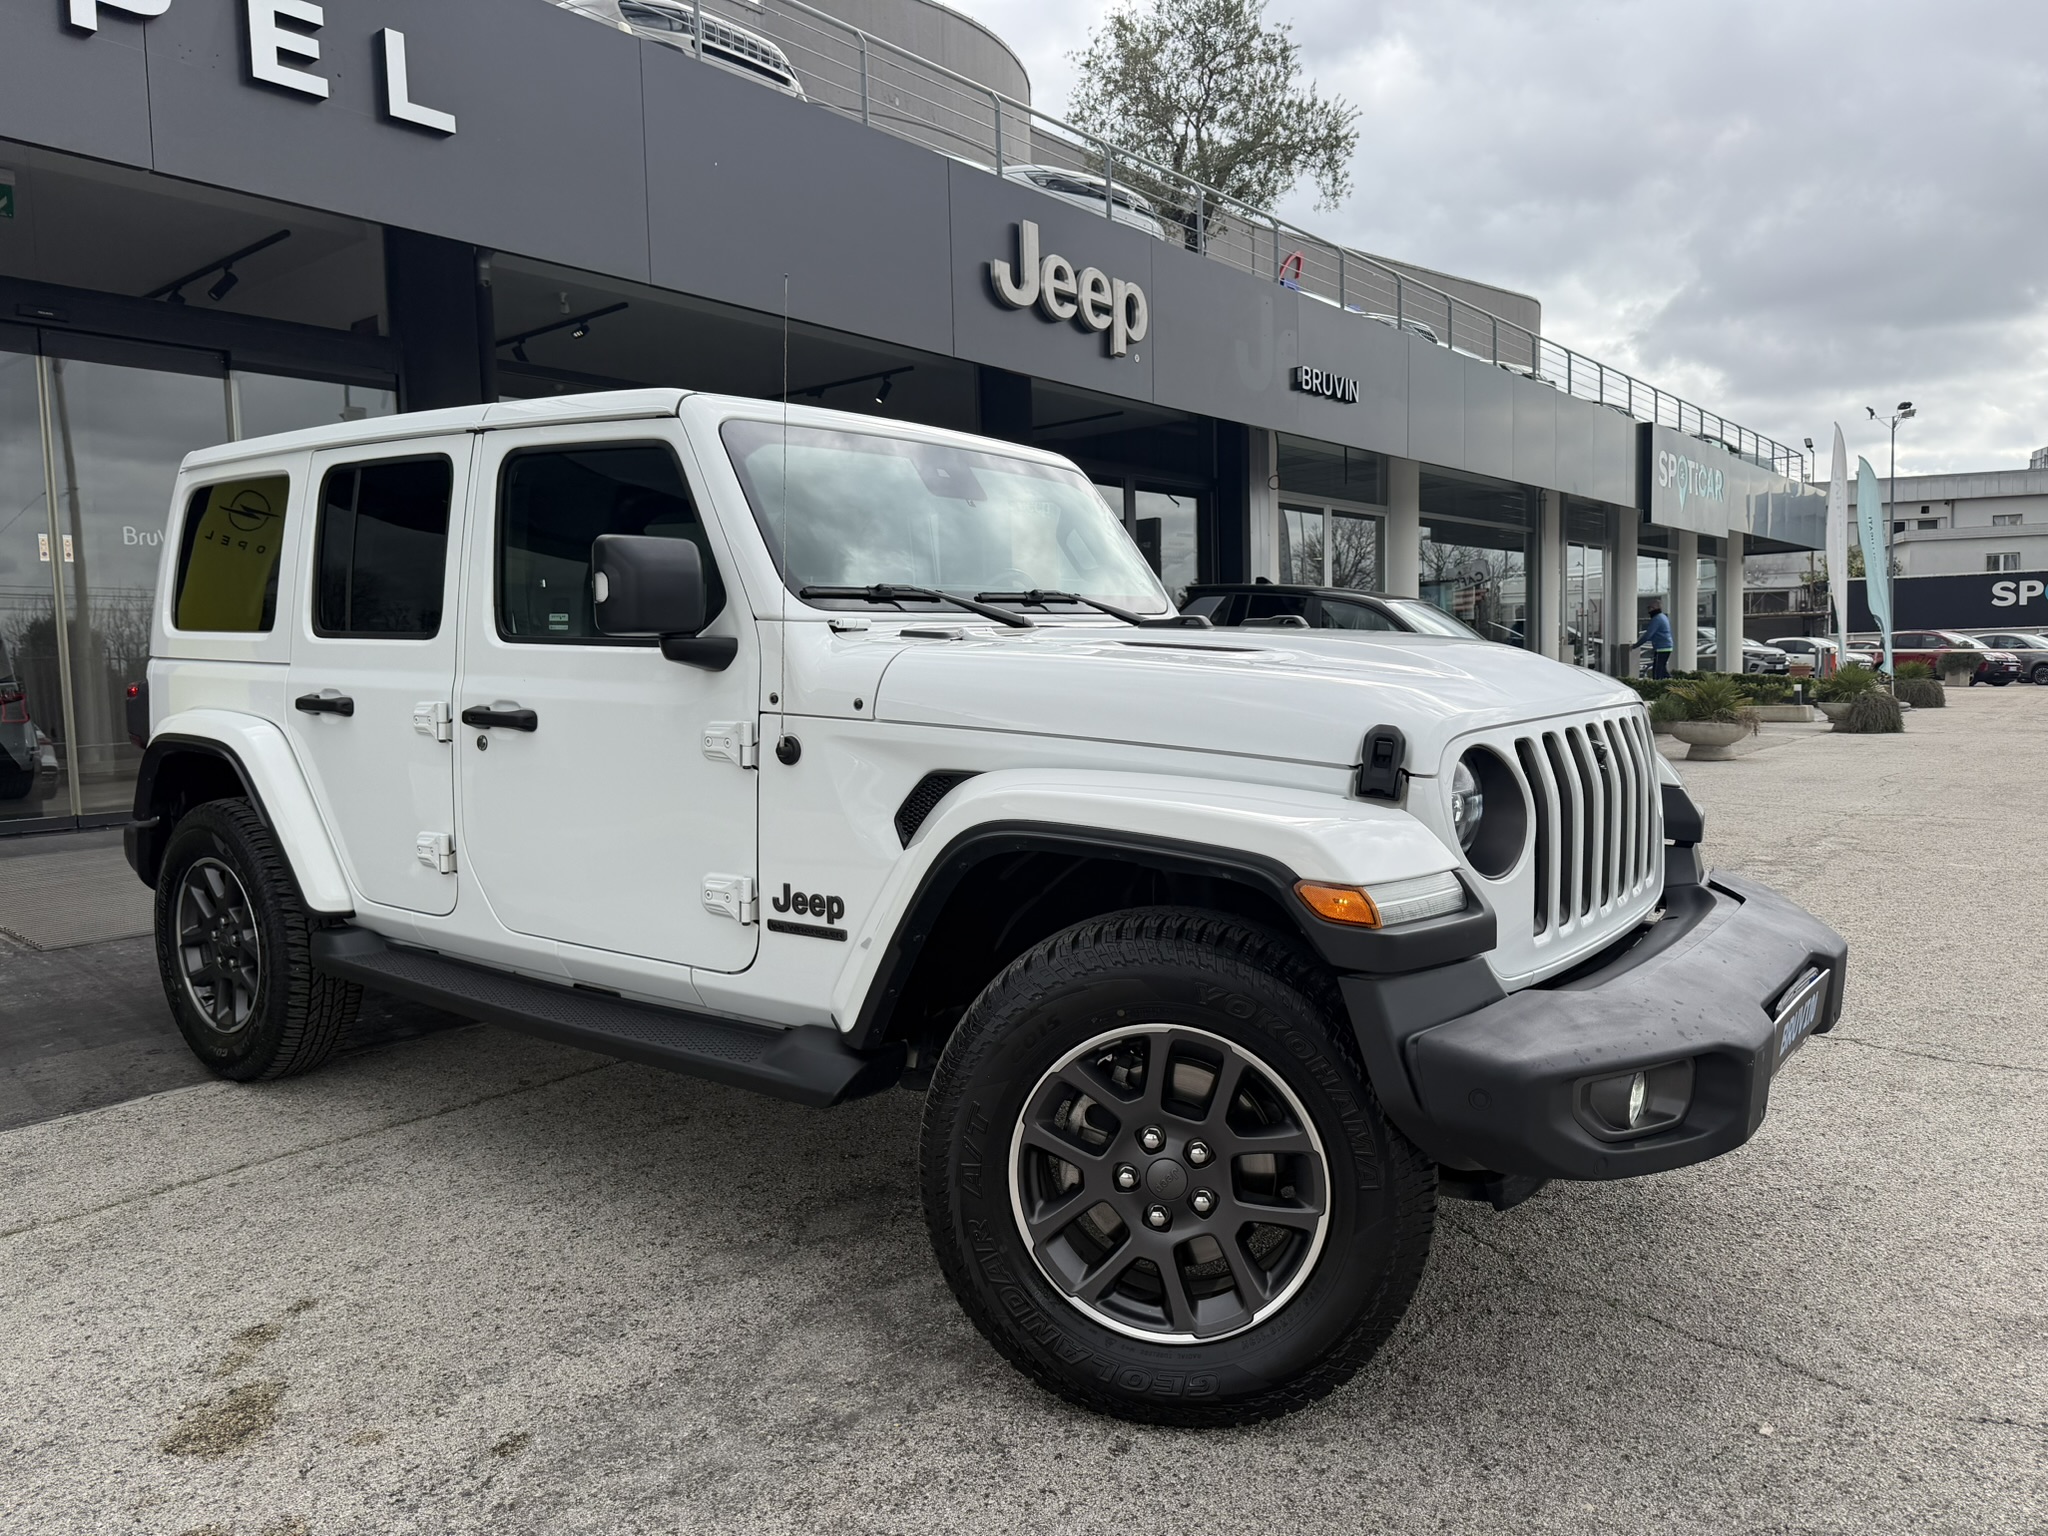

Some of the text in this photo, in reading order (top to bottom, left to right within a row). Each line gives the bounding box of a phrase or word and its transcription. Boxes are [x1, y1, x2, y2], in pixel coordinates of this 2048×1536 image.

[64, 0, 457, 137] EL
[989, 219, 1149, 359] Jeep
[1301, 365, 1360, 403] BRUVIN
[1990, 579, 2048, 607] SP
[771, 882, 846, 926] Jeep
[1779, 990, 1819, 1057] BRUVIN
[1193, 980, 1382, 1191] YOKOHAMA
[1155, 1168, 1180, 1193] Jeep
[968, 1219, 1222, 1398] GEOLANDAR
